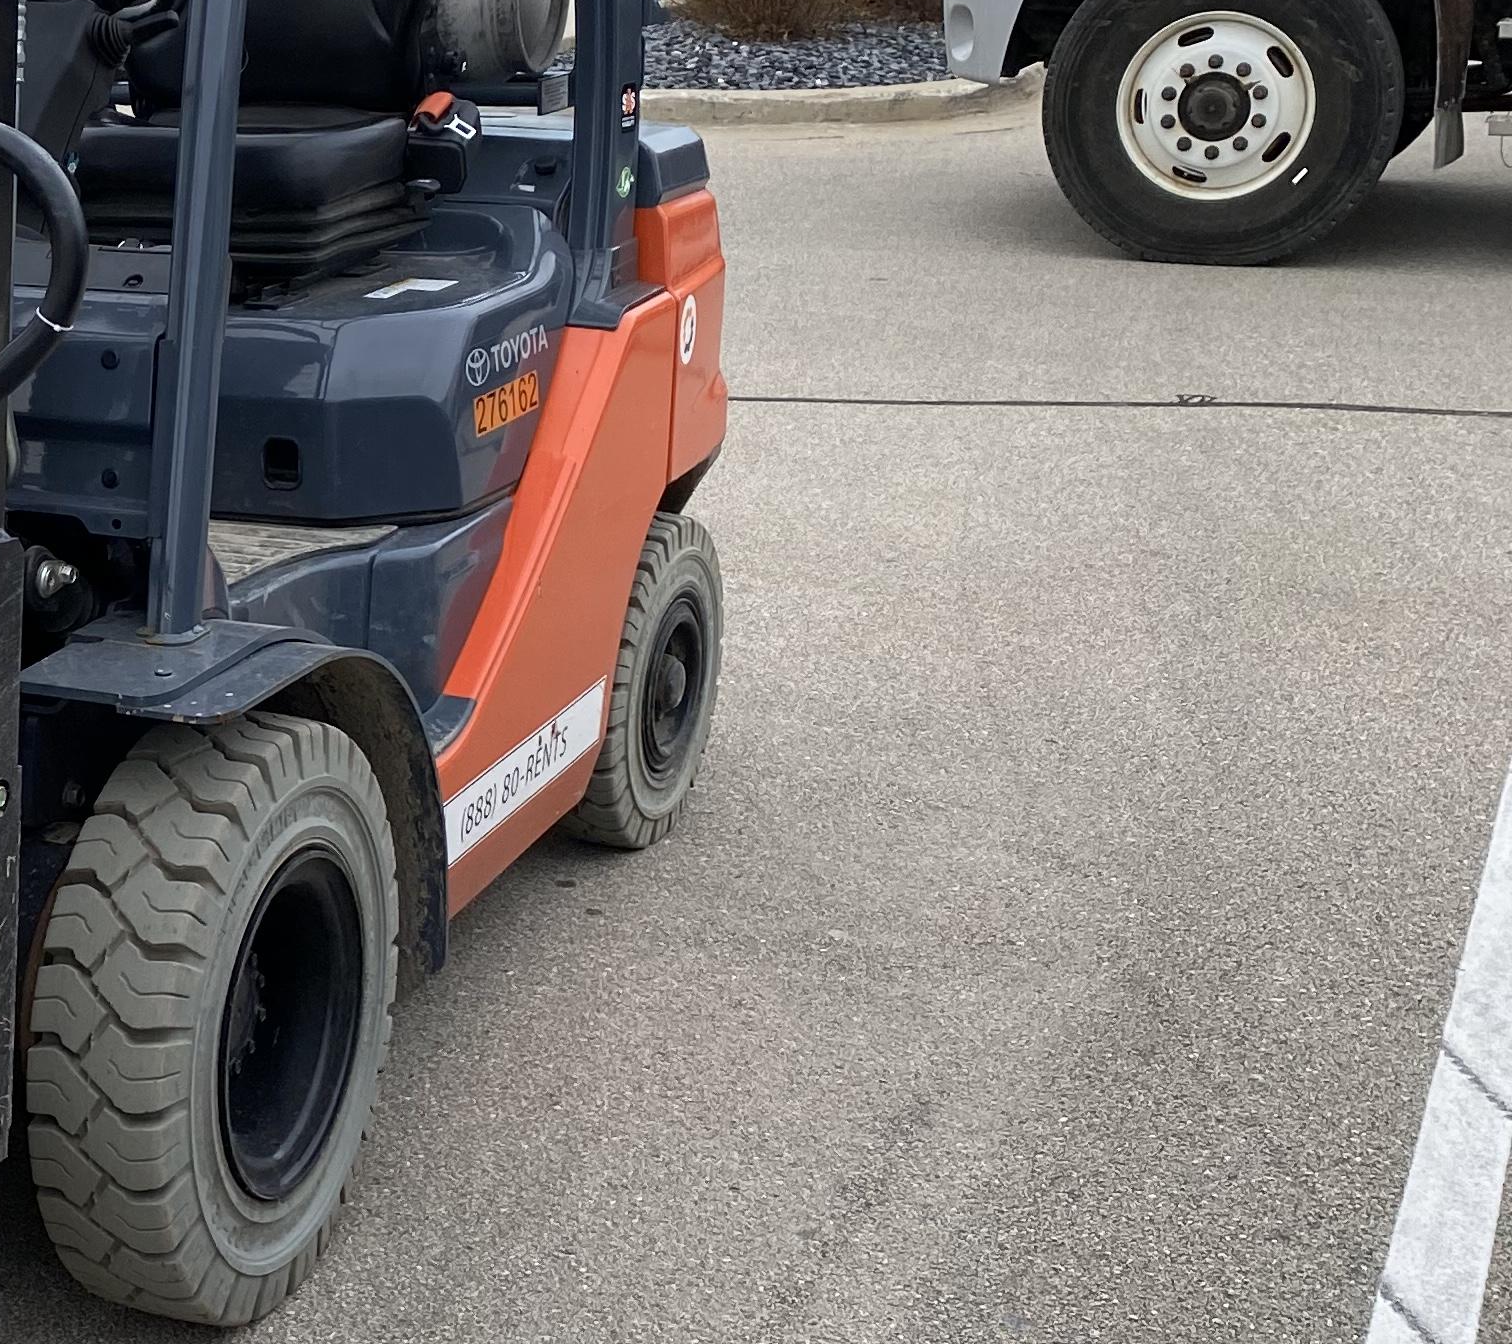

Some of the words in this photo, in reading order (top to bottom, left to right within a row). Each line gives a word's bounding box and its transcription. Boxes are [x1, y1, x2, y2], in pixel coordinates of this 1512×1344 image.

[490, 324, 549, 373] TOYOTA
[475, 372, 538, 434] 276162
[460, 783, 497, 843] (888)
